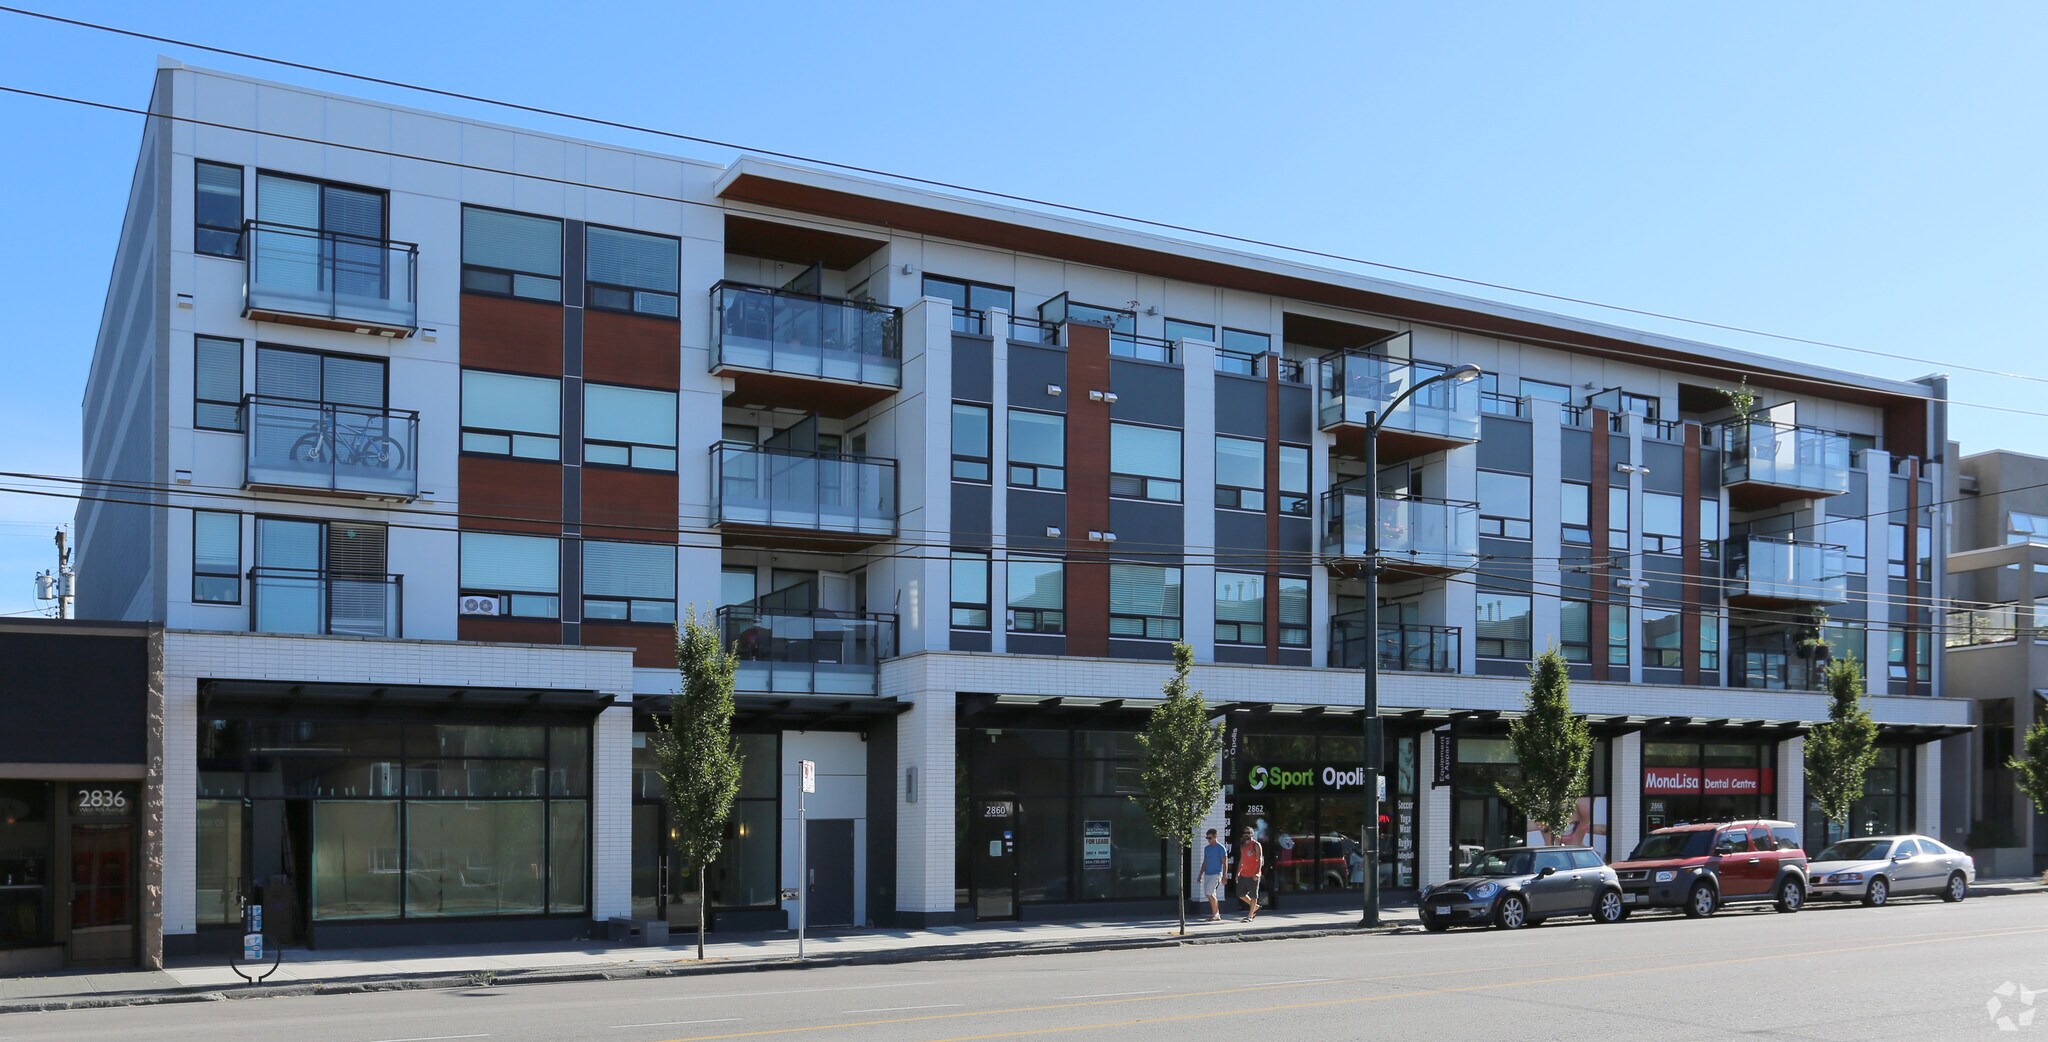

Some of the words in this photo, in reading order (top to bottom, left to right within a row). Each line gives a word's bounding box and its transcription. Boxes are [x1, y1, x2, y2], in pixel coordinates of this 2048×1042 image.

[1270, 766, 1314, 790] Sport
[1322, 766, 1365, 790] Opoli
[1645, 772, 1699, 789] MonaLisa
[1704, 778, 1729, 789] Dental
[1731, 778, 1757, 789] Centre
[79, 790, 126, 807] 2836
[986, 806, 1006, 814] 2860
[1247, 804, 1264, 813] 2862
[1398, 800, 1413, 810] Soccer
[1400, 814, 1411, 825] Yoga
[1399, 824, 1411, 833] Wear
